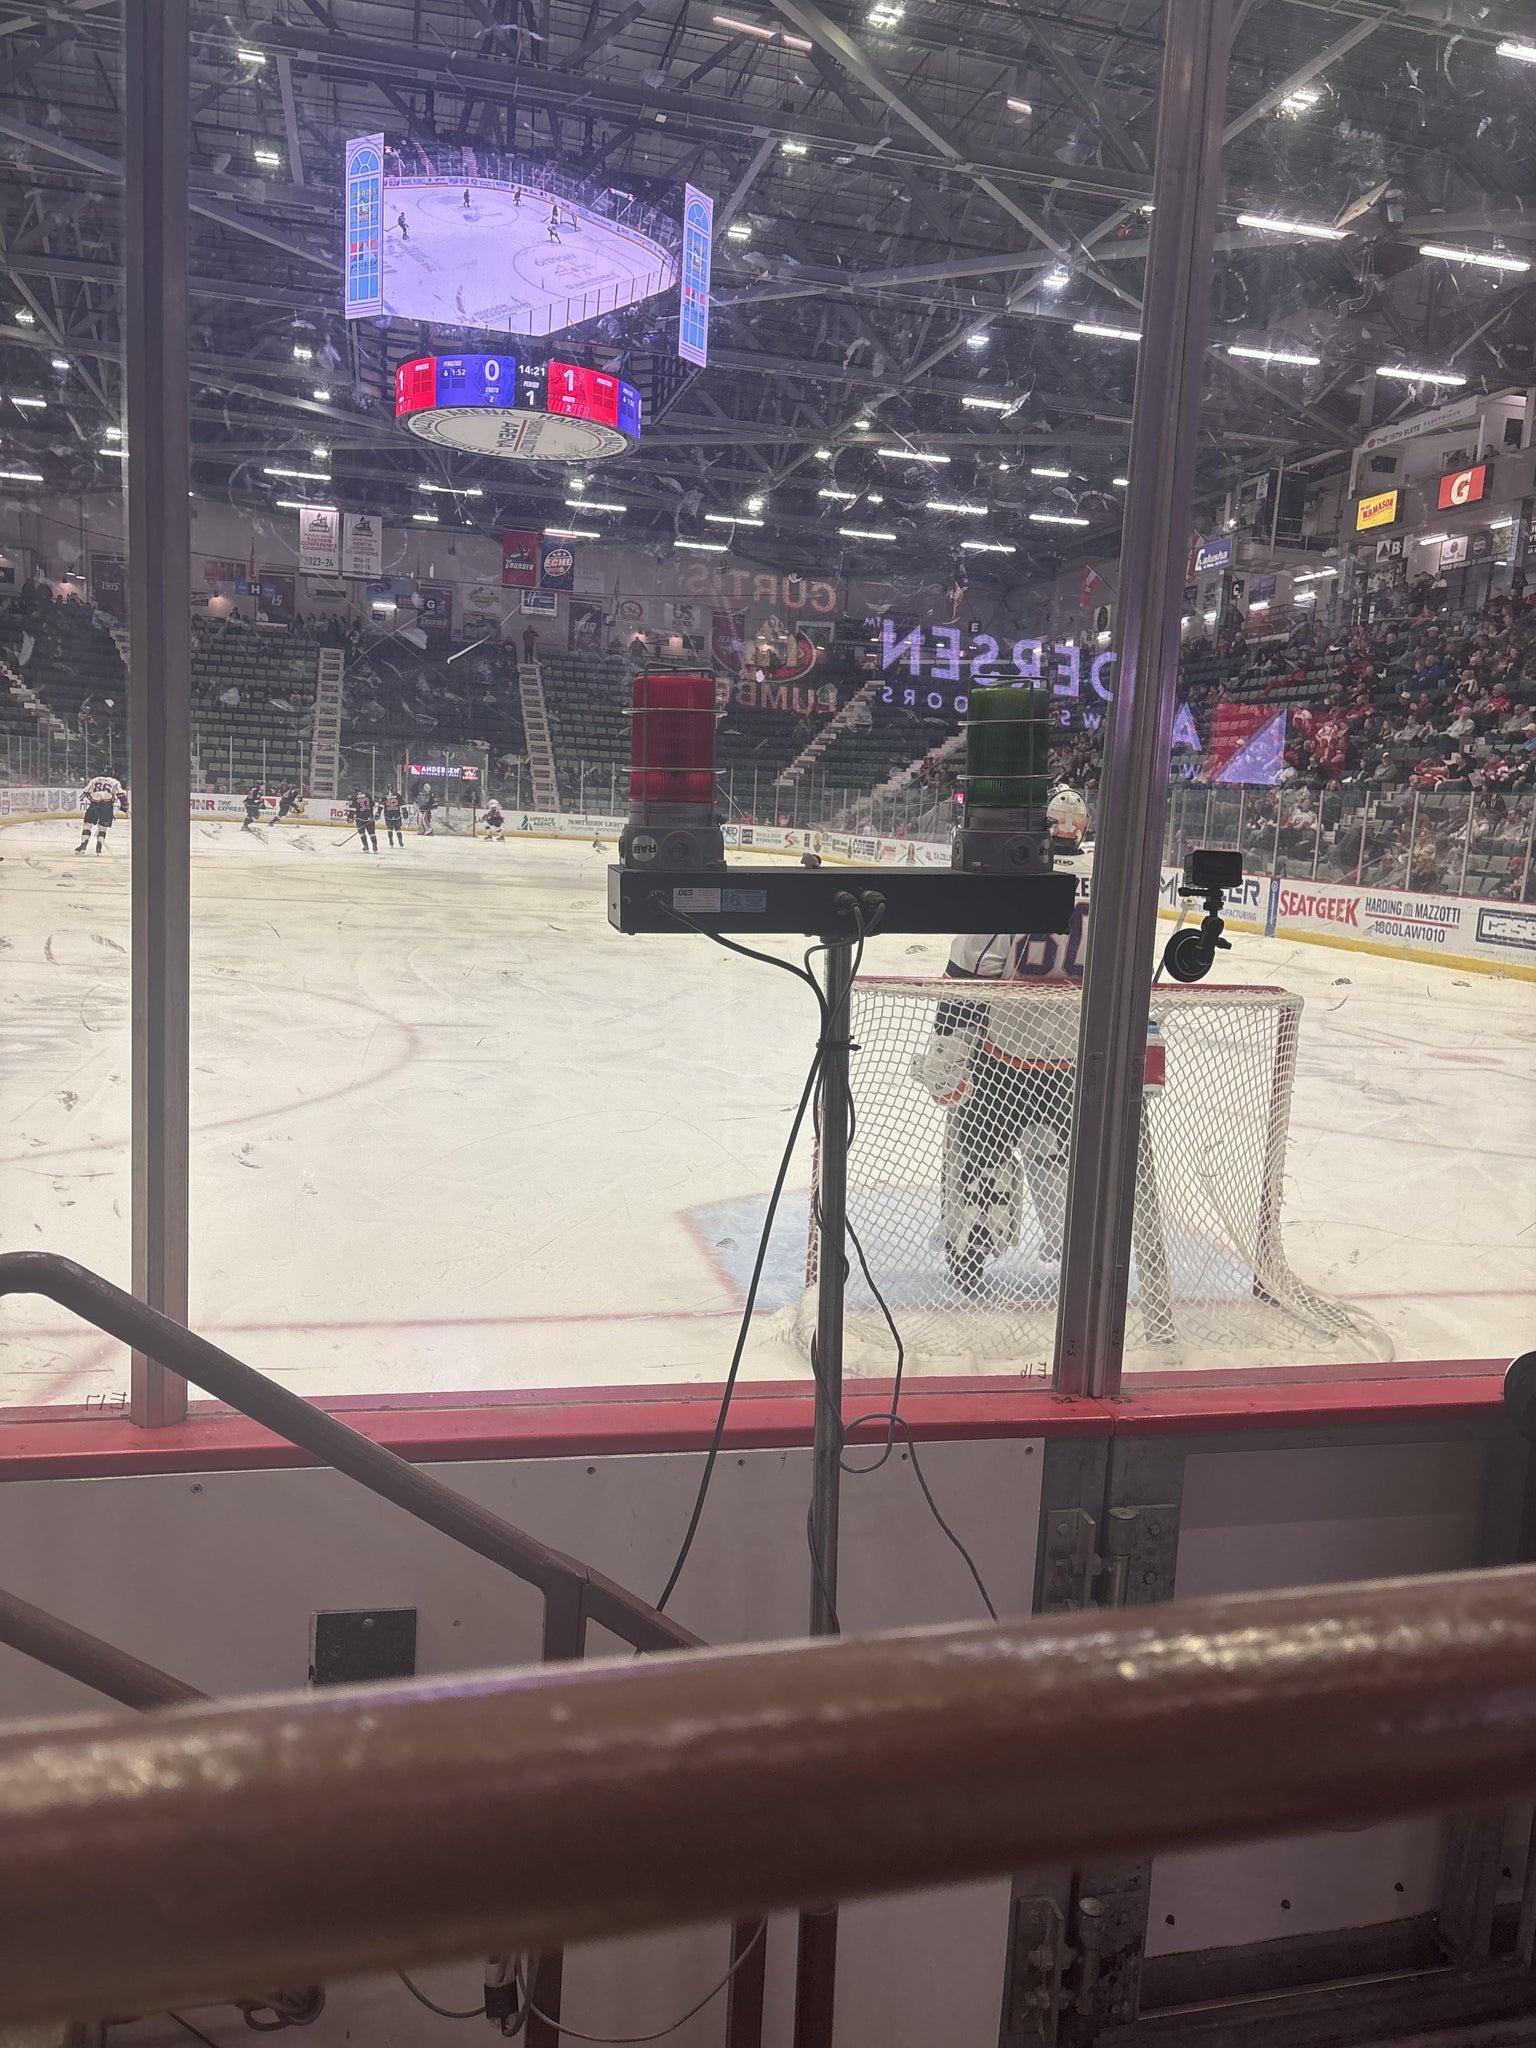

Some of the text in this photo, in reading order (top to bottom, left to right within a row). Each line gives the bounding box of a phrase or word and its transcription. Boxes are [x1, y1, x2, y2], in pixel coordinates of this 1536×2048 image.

[485, 360, 500, 381] 0
[518, 365, 545, 376] 14:21
[563, 369, 574, 391] 1
[489, 395, 495, 403] 2
[526, 390, 535, 406] 1
[566, 404, 572, 412] 2
[495, 421, 520, 449] ARENA
[1376, 435, 1389, 445] THE
[1403, 424, 1421, 437] SUITE
[1450, 471, 1473, 505] G
[1392, 541, 1401, 555] B
[505, 559, 534, 571] THUNDER
[544, 557, 572, 567] ECHL
[101, 581, 120, 591] THIS
[251, 584, 260, 594] H
[426, 600, 436, 609] G
[971, 623, 979, 632] E
[421, 765, 461, 775] ANDERSEN
[93, 782, 112, 793] 86
[532, 820, 557, 828] AGENCY
[633, 844, 657, 854] RAB
[1279, 889, 1361, 927] SEATGEEK
[1364, 896, 1461, 924] HARDING MAZZOTTI
[1374, 920, 1446, 944] 1800LAW1010
